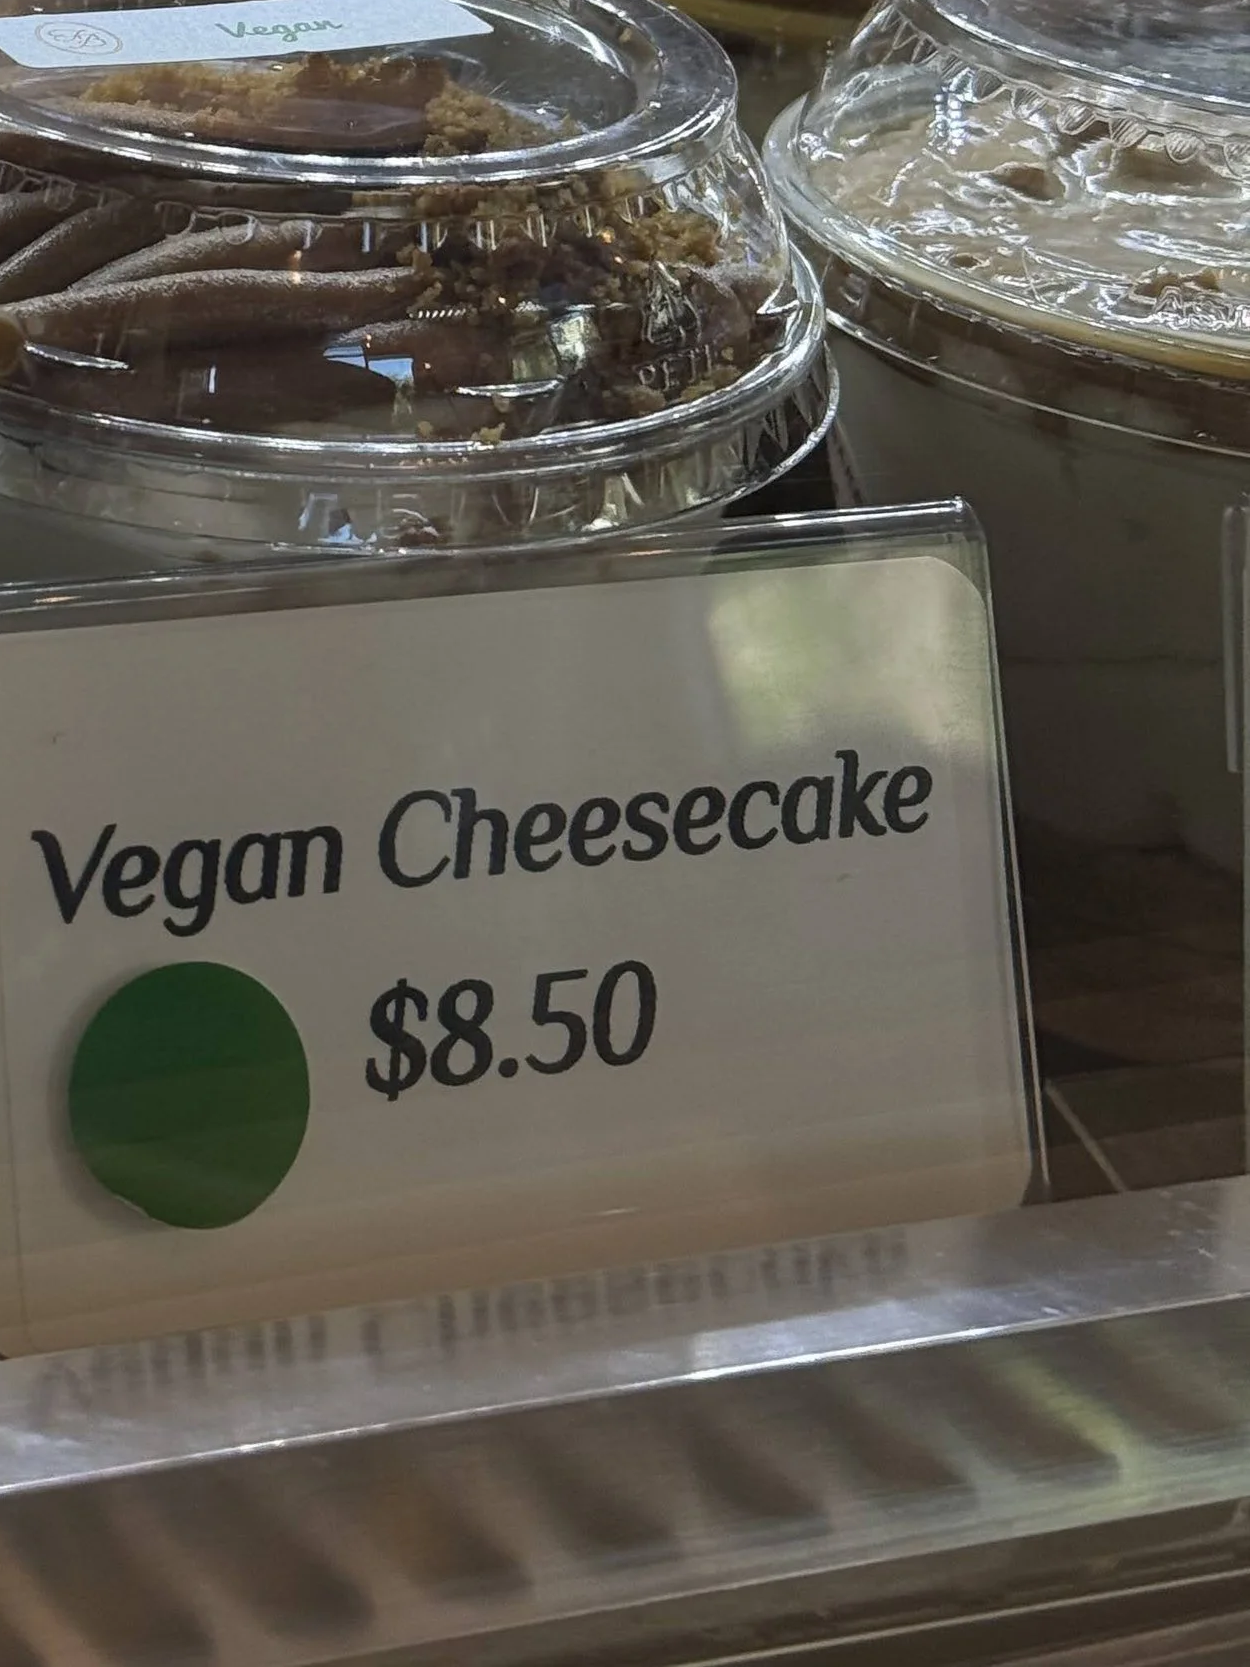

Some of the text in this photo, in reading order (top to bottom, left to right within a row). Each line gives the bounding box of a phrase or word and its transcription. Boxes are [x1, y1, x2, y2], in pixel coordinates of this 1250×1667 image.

[215, 21, 343, 42] Vegan
[30, 749, 934, 938] Vegan Cheesecake
[365, 959, 657, 1102] $8.50
